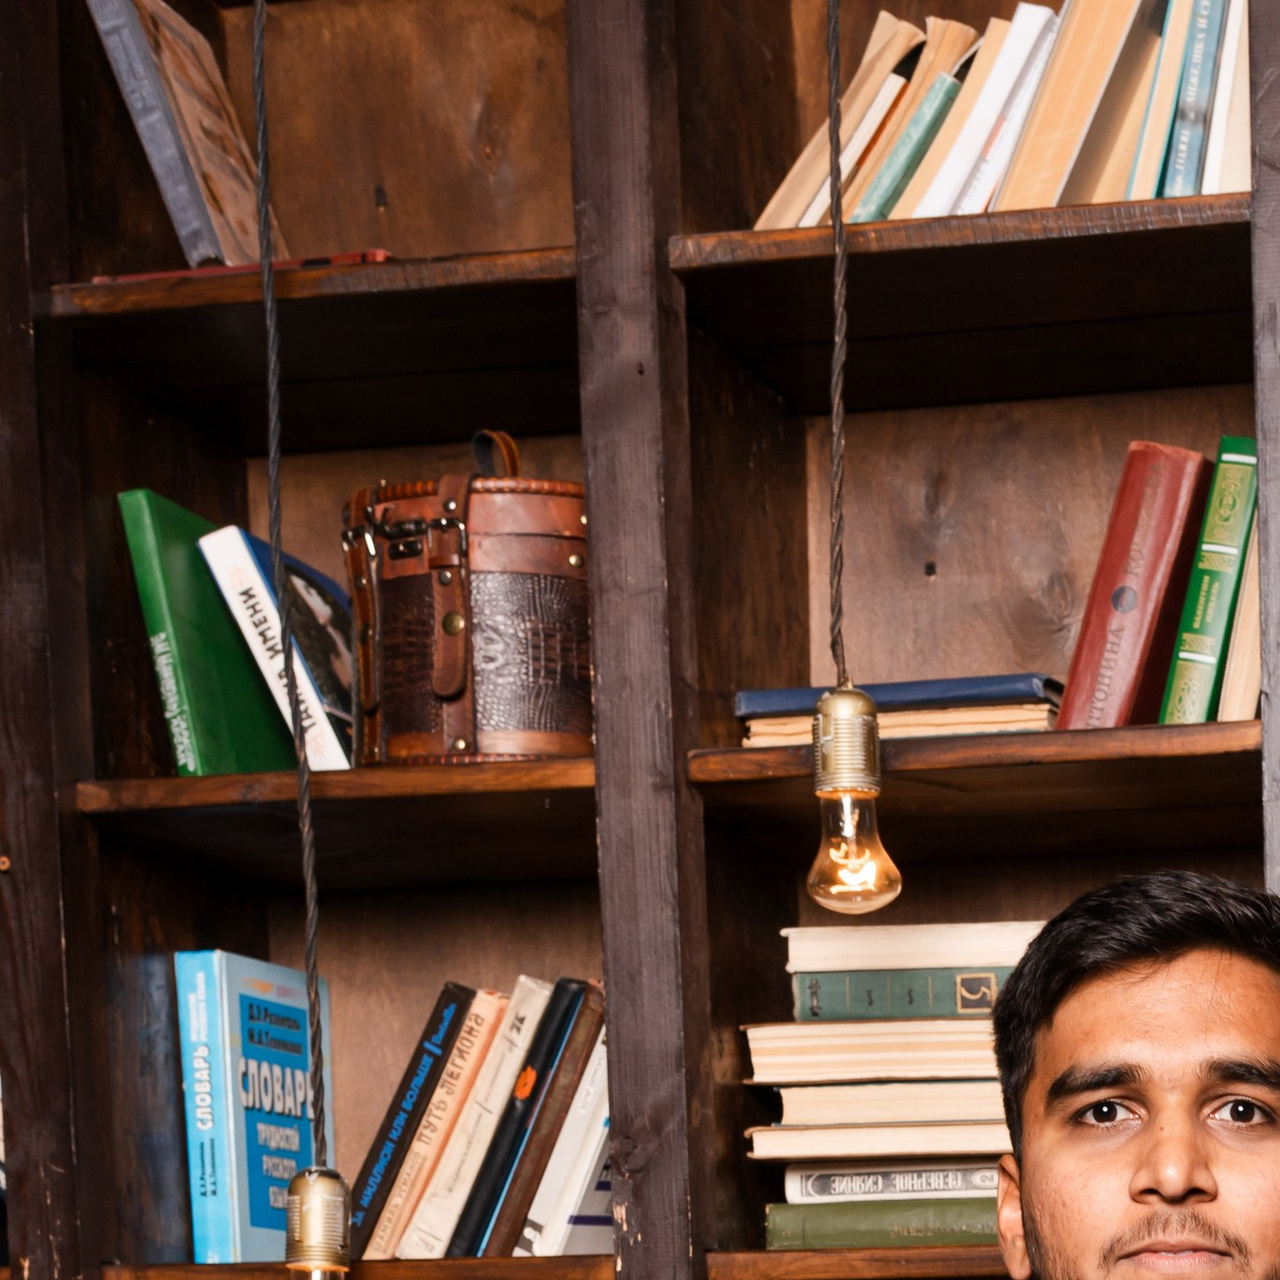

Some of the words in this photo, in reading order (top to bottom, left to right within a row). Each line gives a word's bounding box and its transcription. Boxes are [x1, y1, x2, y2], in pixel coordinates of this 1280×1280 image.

[239, 586, 284, 661] ИМЕНИ
[193, 1045, 214, 1130] СЛОВАРЬ
[237, 1057, 315, 1120] СЛОВАРЬ
[360, 1145, 395, 1209] МИЛЛИОН
[388, 1113, 408, 1146] ИЛИ
[402, 1053, 435, 1112] БОЛЬШЕ
[416, 1100, 448, 1148] ПУТЬ
[830, 1173, 883, 1195] СИЯНИЕ
[892, 1171, 962, 1193] СЕВЕРНОЕ
